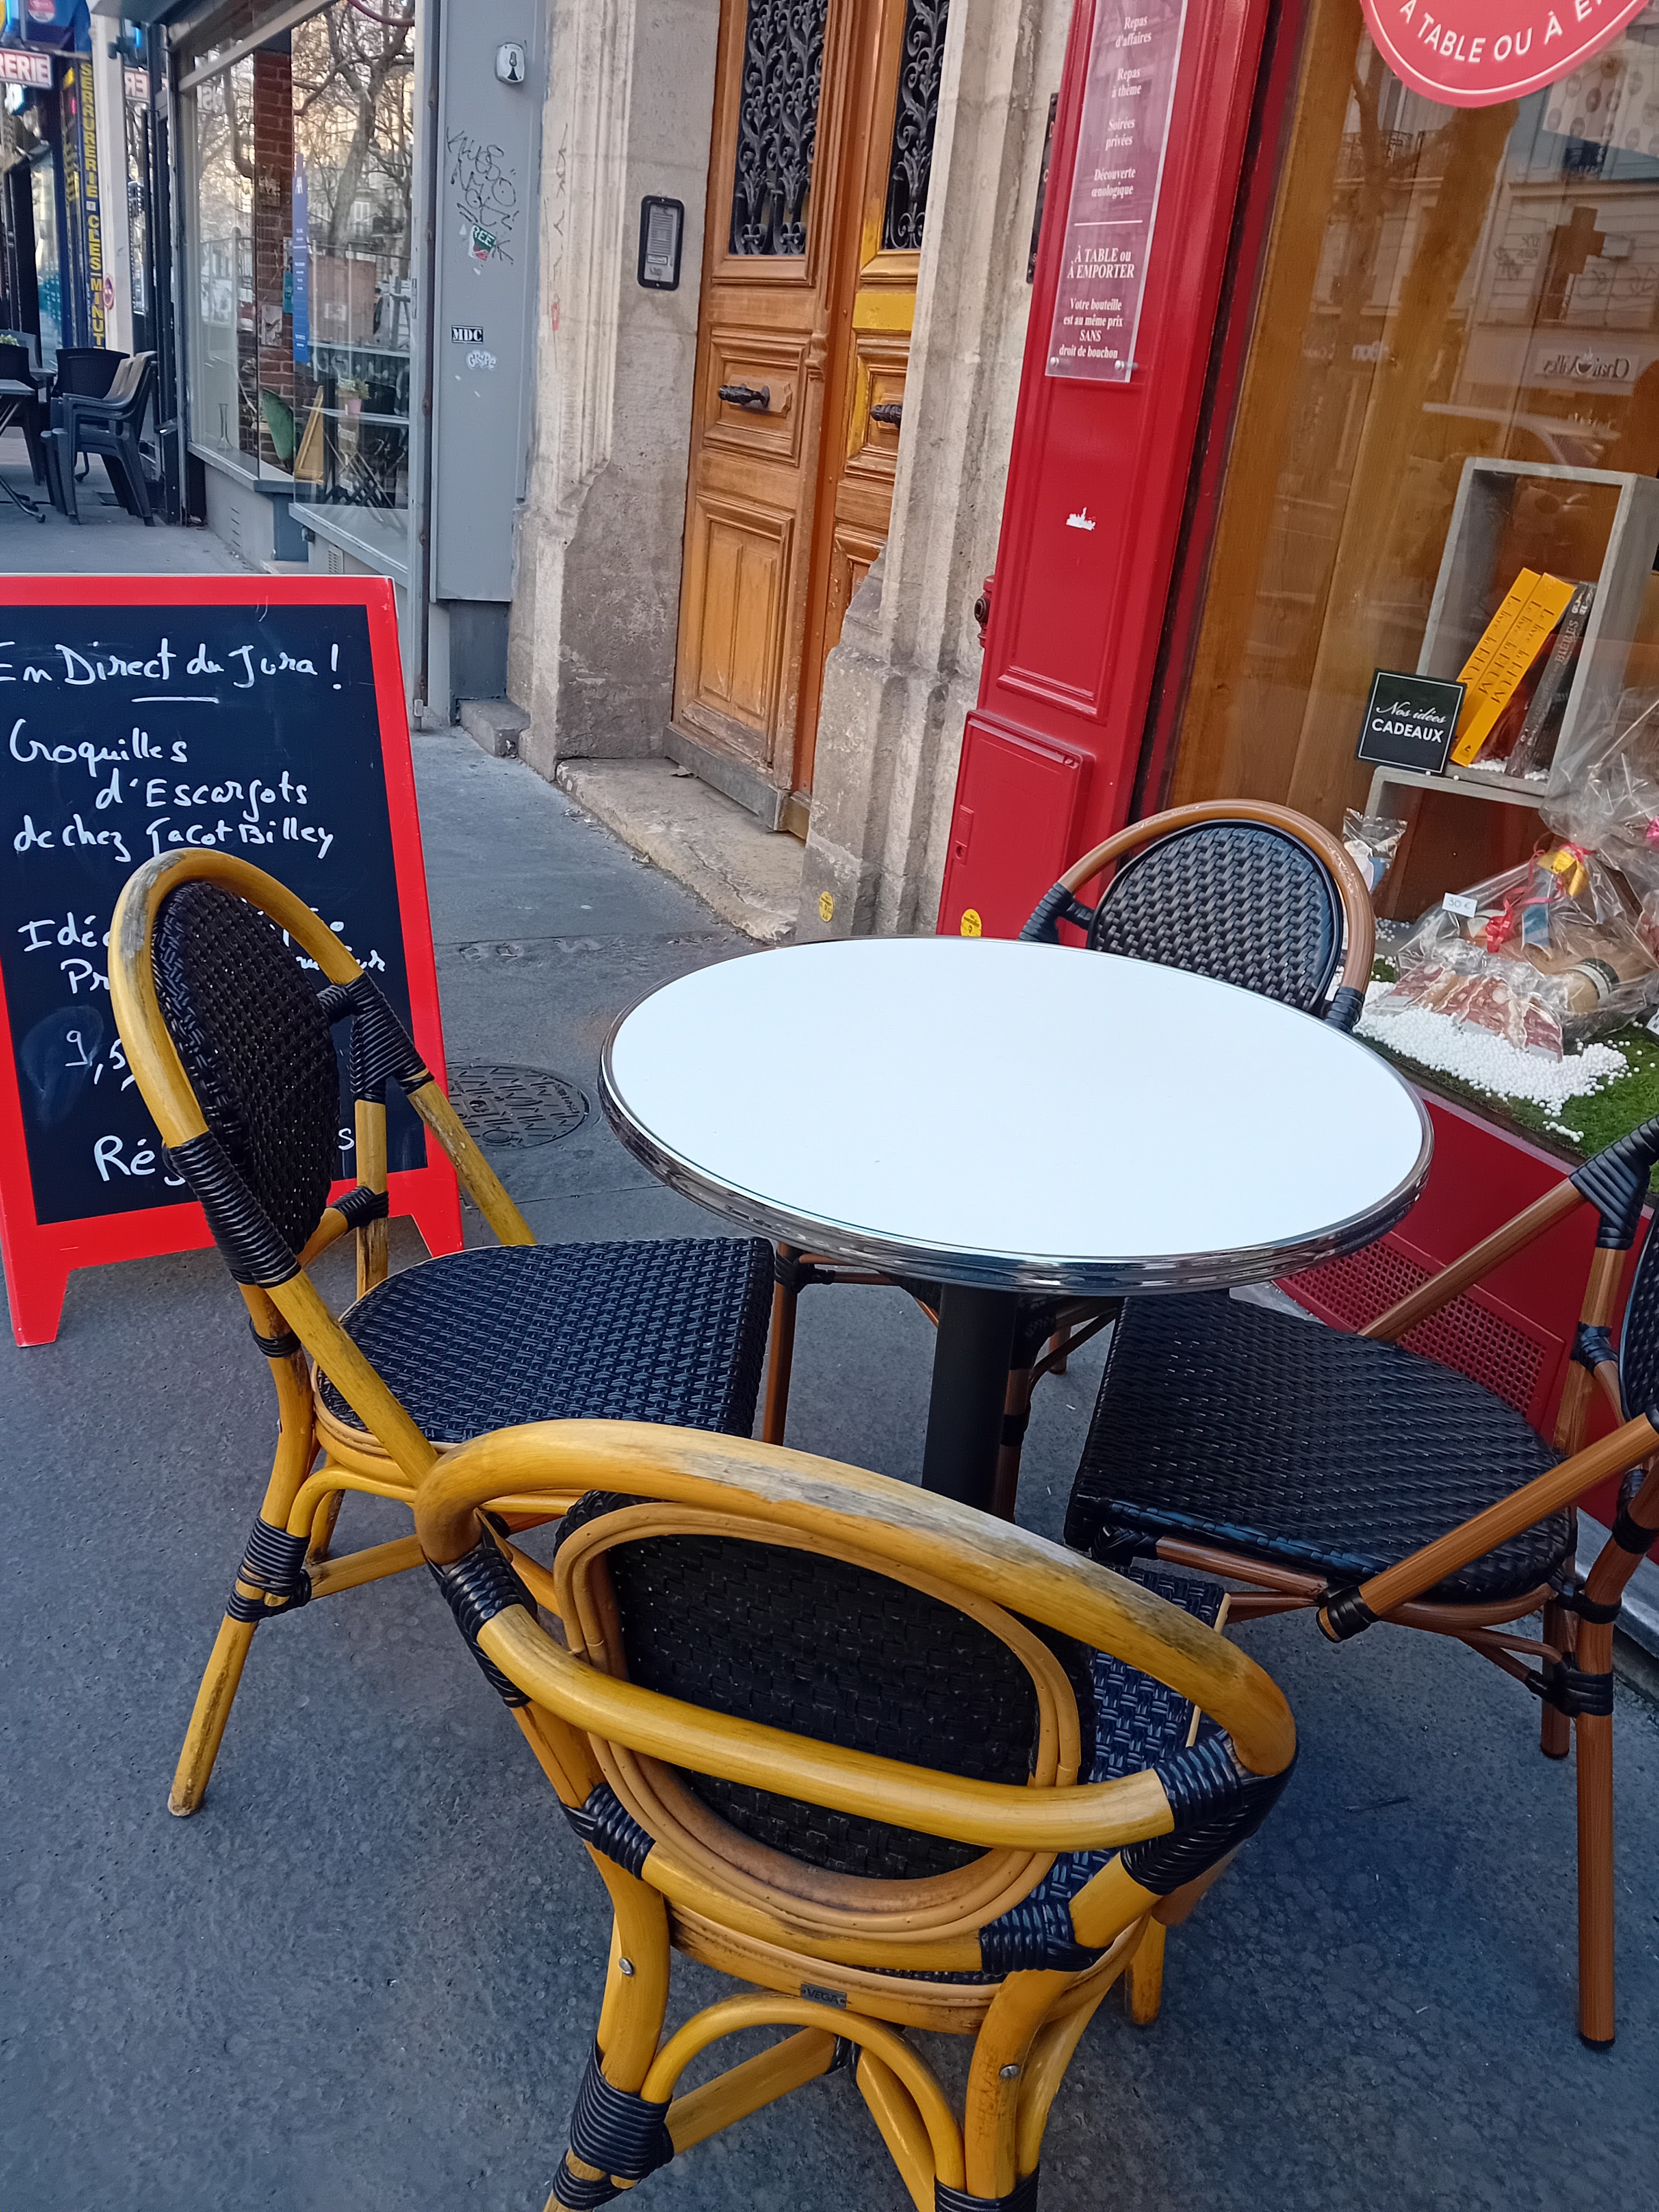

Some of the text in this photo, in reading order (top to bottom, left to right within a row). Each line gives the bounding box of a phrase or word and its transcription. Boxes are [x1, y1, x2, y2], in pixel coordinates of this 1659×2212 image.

[1123, 16, 1148, 31] Repas
[1115, 31, 1152, 48] d'affaires
[1417, 12, 1487, 63] TABLE
[1493, 27, 1533, 61] OU
[1544, 10, 1564, 45] À
[1117, 68, 1141, 81] Repas
[1111, 83, 1142, 98] à thème
[80, 63, 98, 197] SERRURERIE
[1108, 117, 1135, 131] Soirées
[1105, 133, 1133, 151] privées
[1094, 167, 1136, 181] Découverte
[1075, 245, 1131, 263] À TABLE ou
[1067, 260, 1135, 279] À EMPORTER
[1070, 298, 1122, 311] Votre bouteille
[1063, 313, 1123, 330] est au même prix
[453, 328, 482, 341] MDC
[1079, 329, 1102, 342] SANS
[1059, 344, 1118, 359] droit de bouchon
[55, 638, 177, 685] Direct
[186, 643, 224, 674] du
[1375, 701, 1446, 724] Nos idées
[1372, 718, 1444, 743] CADEAUX
[806, 1988, 839, 2005] VEGA
